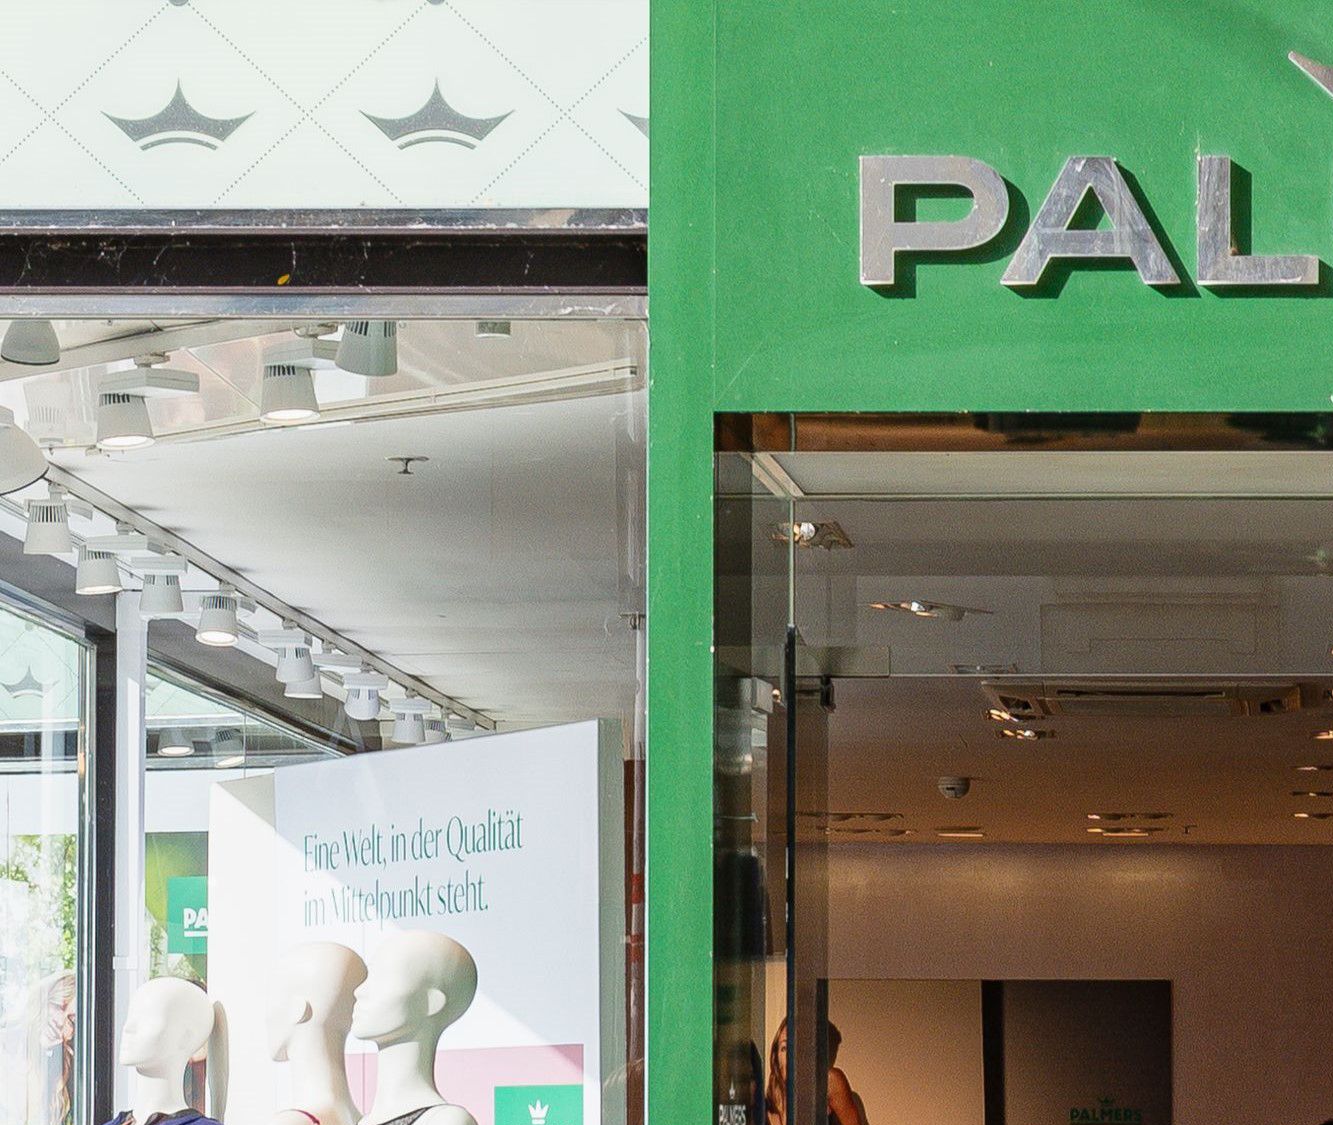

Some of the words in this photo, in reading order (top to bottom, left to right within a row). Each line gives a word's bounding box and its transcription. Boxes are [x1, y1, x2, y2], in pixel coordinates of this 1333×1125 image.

[303, 833, 340, 872] Eine
[343, 823, 388, 873] Welt,
[390, 824, 407, 863] in
[411, 816, 443, 861] der
[446, 808, 524, 862] Qualität
[304, 889, 325, 927] im
[331, 875, 433, 931] Mittelpunkt
[437, 869, 489, 915] steht.
